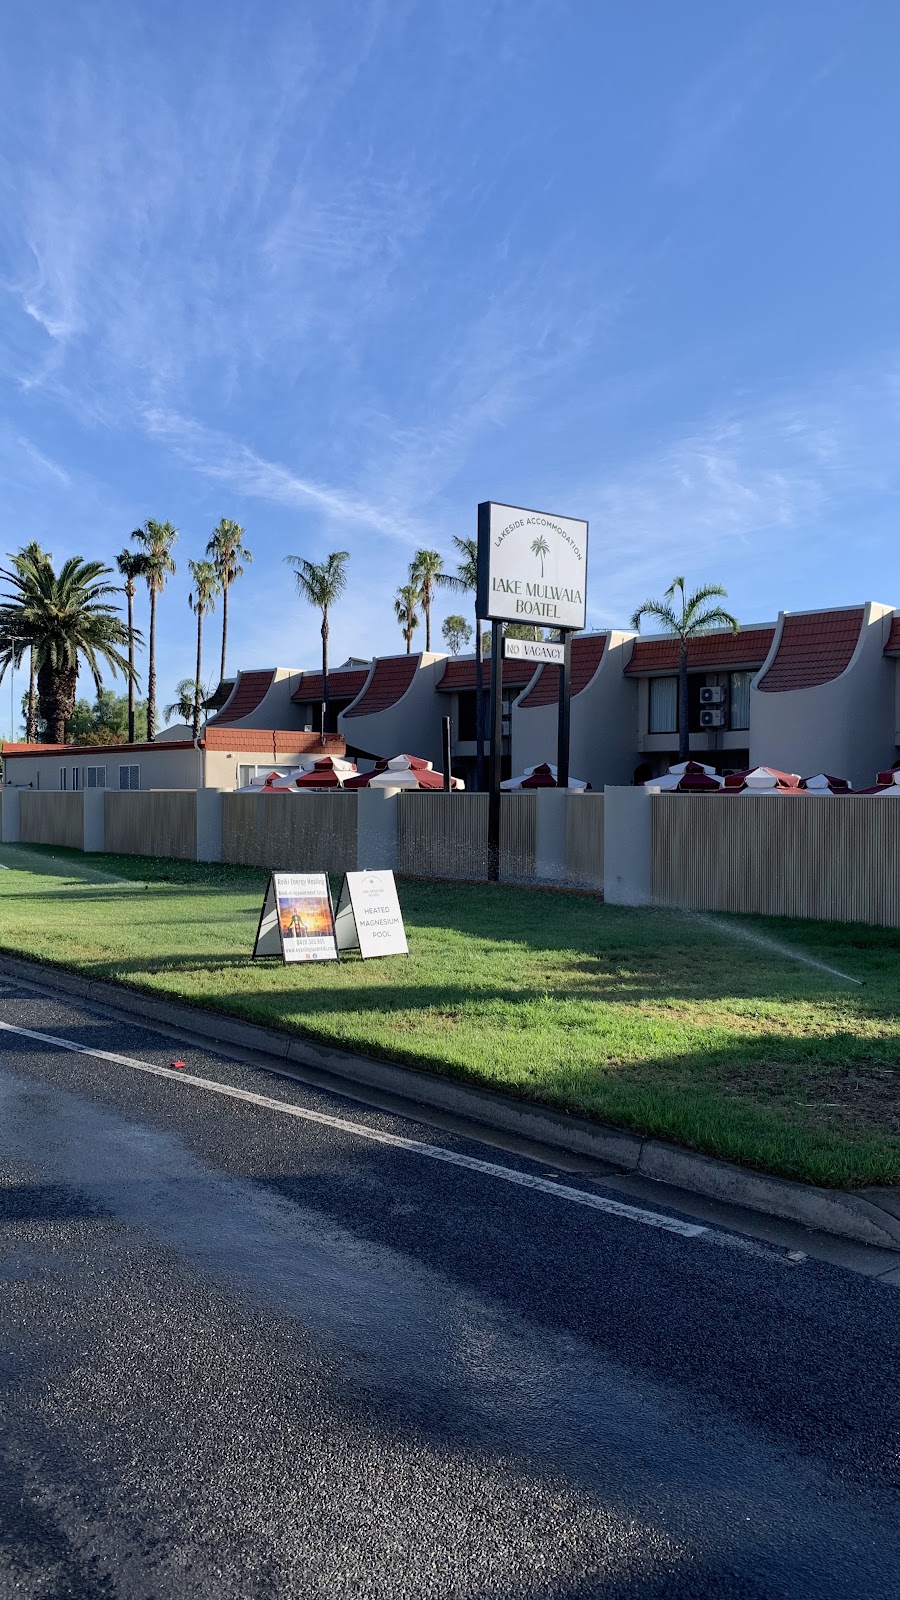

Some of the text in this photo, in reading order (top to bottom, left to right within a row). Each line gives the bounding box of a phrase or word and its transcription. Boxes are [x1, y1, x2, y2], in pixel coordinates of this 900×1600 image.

[494, 517, 583, 561] LAKESIDE ACCOMMODATION
[492, 577, 583, 604] LAKE MULWALA
[515, 599, 561, 619] BOATEL
[507, 643, 563, 660] NO VACANCY
[277, 878, 325, 887] Reiki Energy Healing
[364, 906, 390, 915] HEATED
[359, 918, 400, 928] MAGNESIUM
[372, 930, 392, 938] POOL
